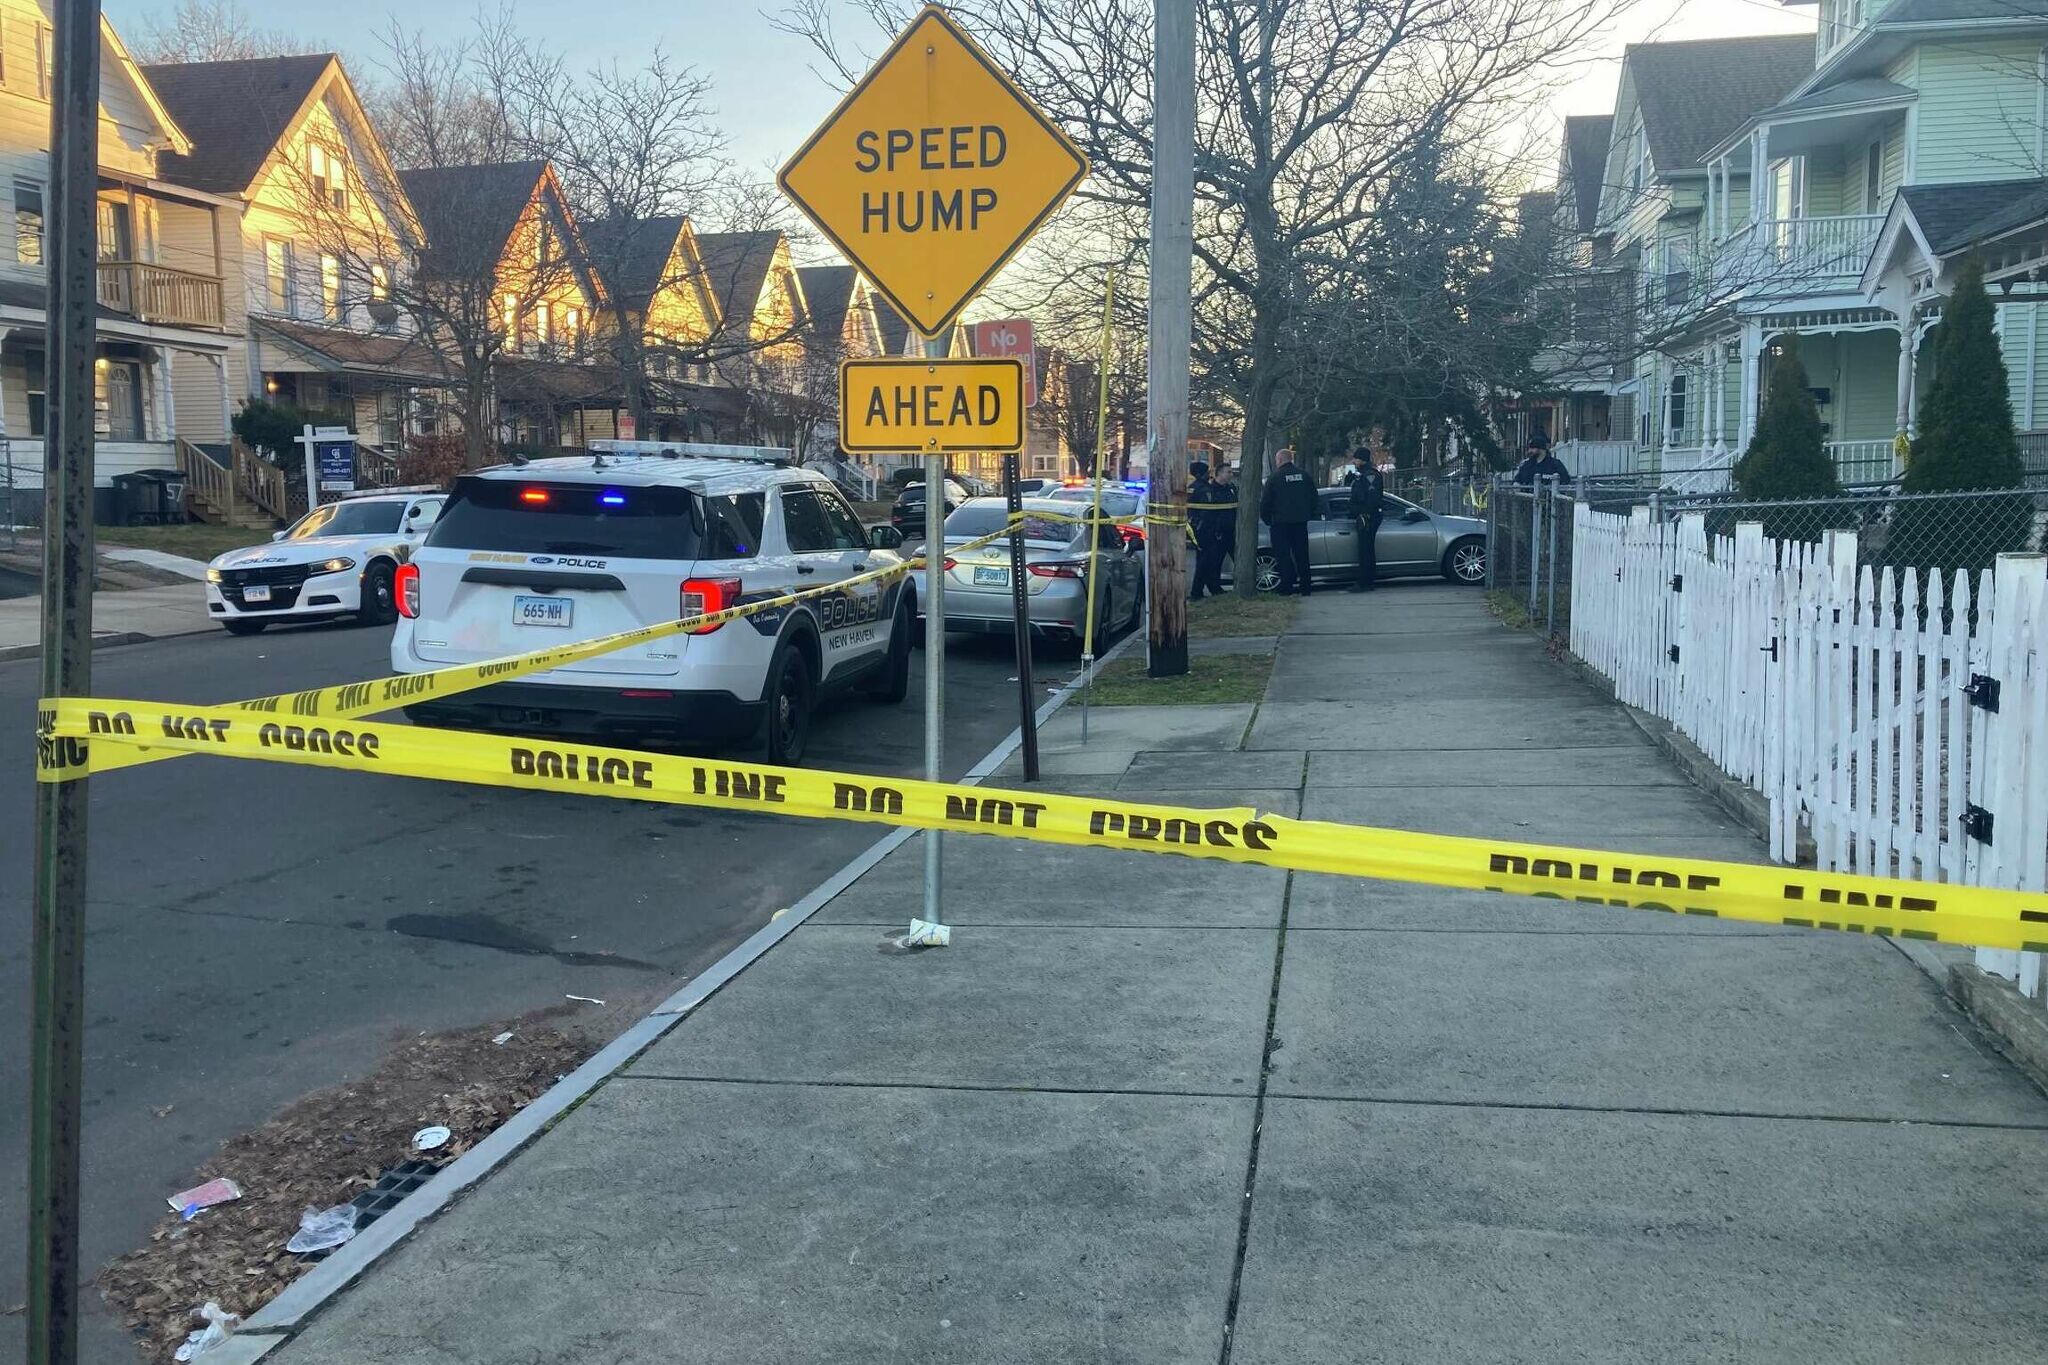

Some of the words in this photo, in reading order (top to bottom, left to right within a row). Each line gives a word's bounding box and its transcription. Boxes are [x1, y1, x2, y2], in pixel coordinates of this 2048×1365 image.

[855, 125, 1007, 173] SPEED
[862, 187, 998, 234] HUMP
[991, 329, 1018, 348] No
[865, 385, 1001, 427] AHEAD
[166, 483, 184, 502] 57
[557, 557, 607, 569] POLICE
[820, 594, 878, 631] POLICE
[829, 634, 848, 651] NEW
[850, 628, 875, 646] HAVEN
[511, 747, 653, 789] POLICE
[693, 767, 787, 803] LINE
